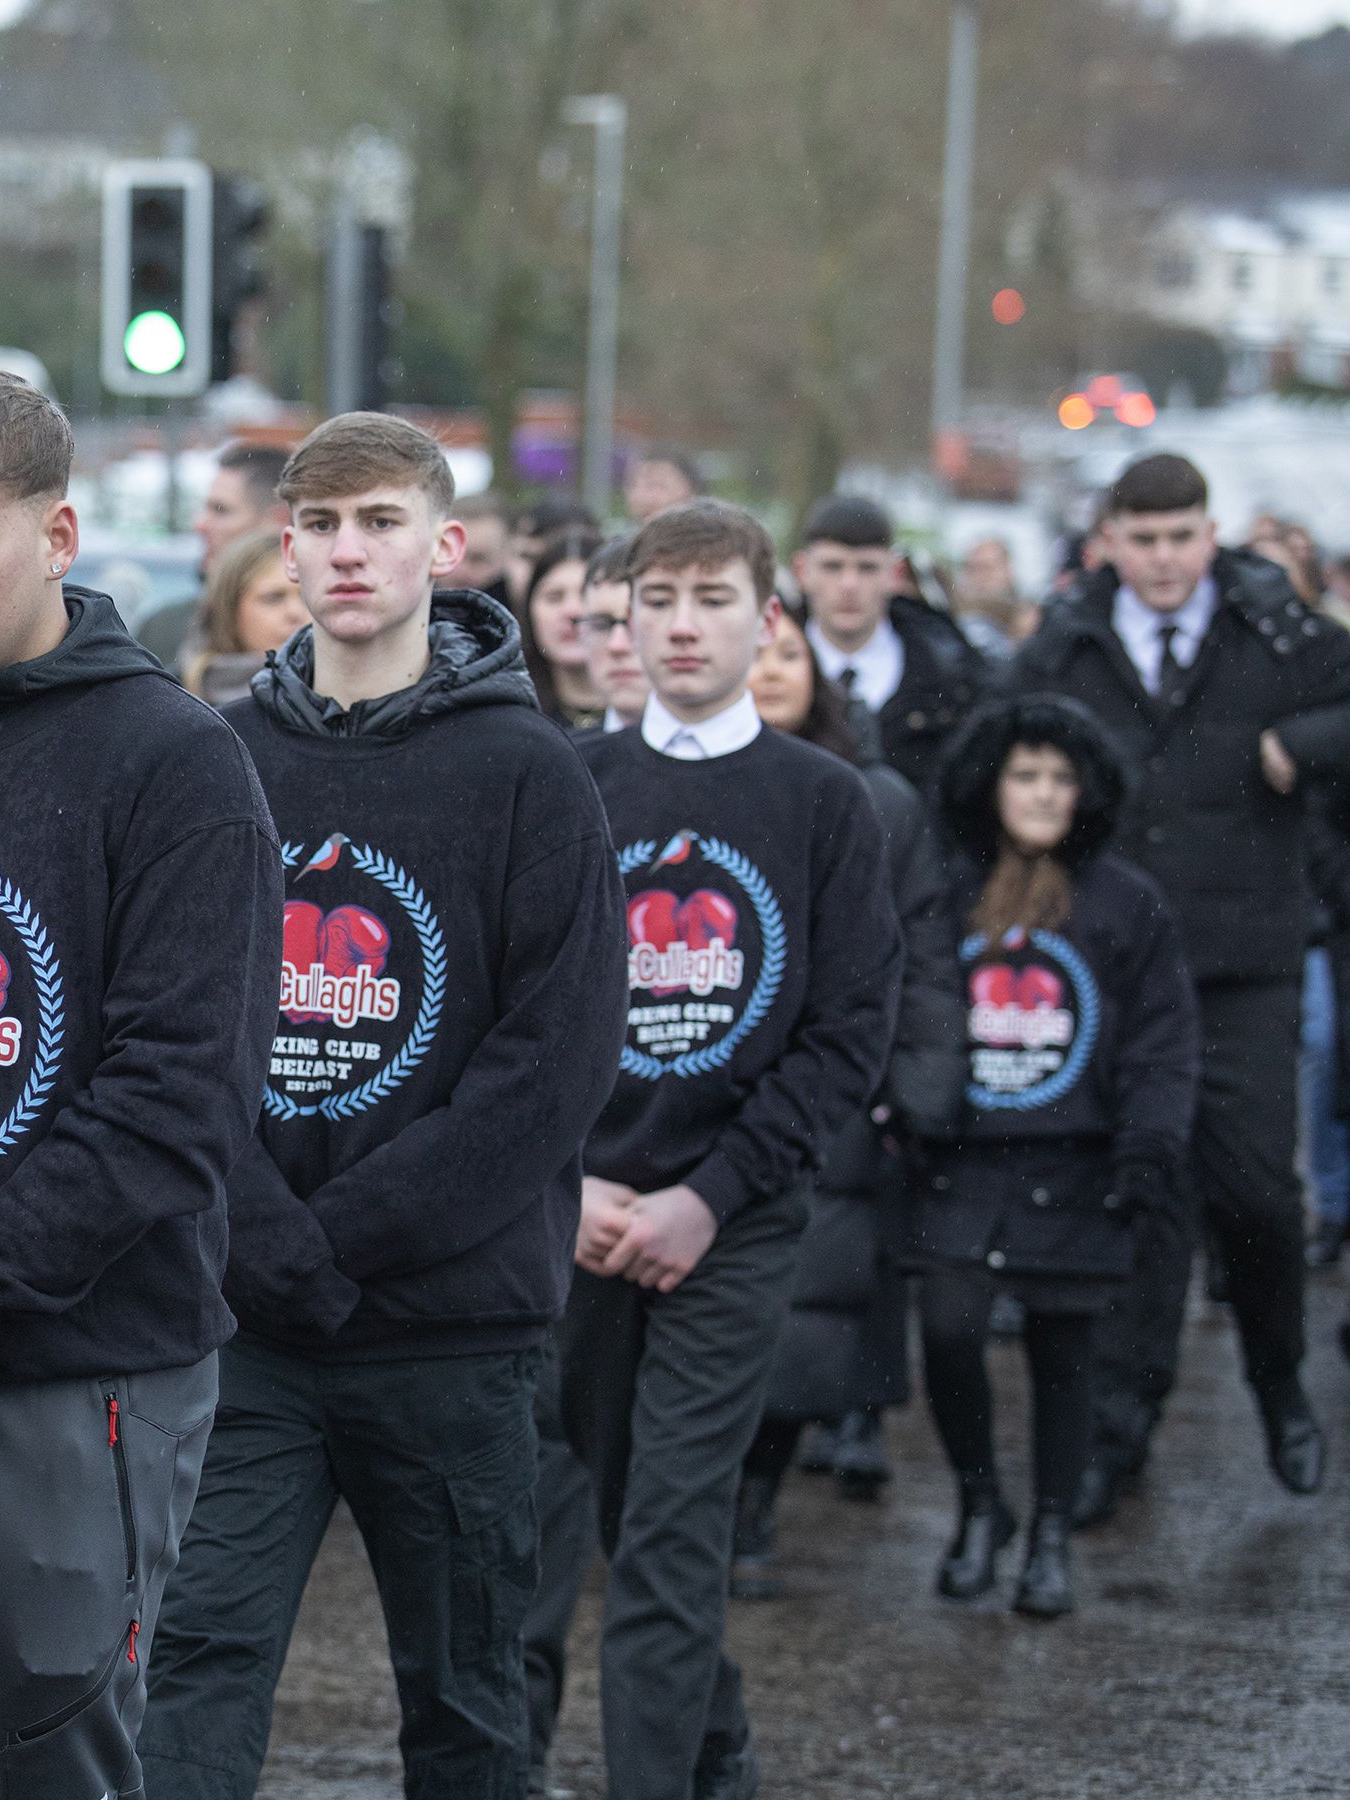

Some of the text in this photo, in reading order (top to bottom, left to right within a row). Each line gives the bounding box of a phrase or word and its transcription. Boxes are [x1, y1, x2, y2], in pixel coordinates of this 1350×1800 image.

[279, 960, 401, 1029] Cullaghs
[628, 937, 744, 996] Cullaghs
[325, 1039, 381, 1061] CLUB
